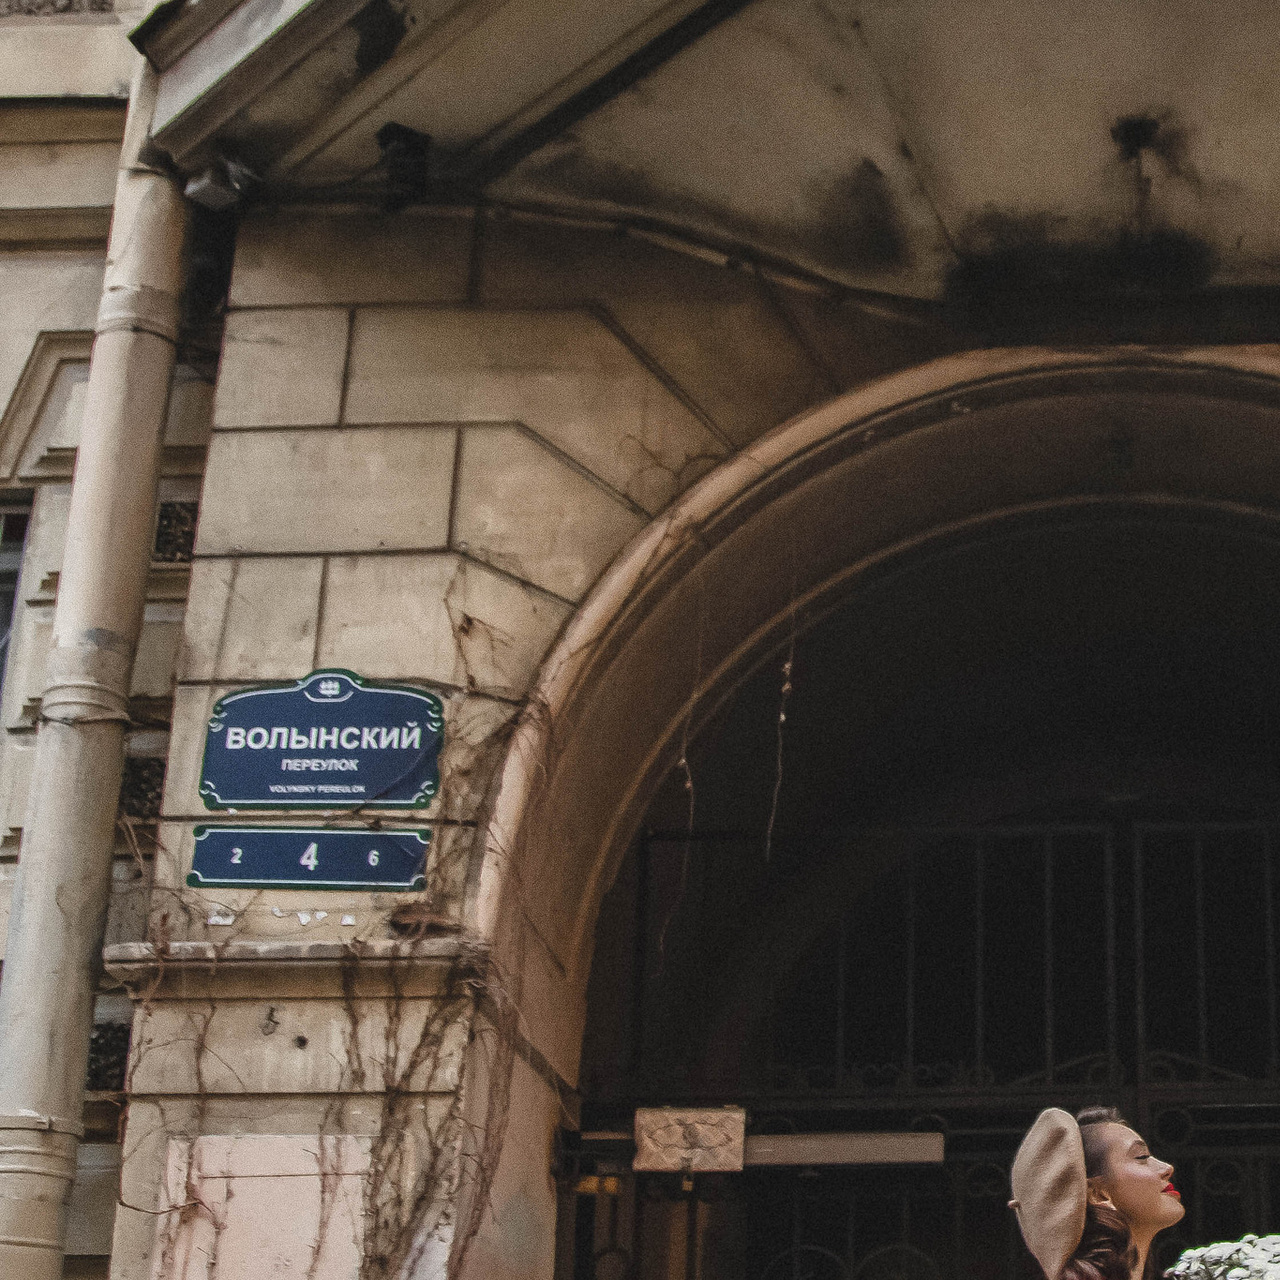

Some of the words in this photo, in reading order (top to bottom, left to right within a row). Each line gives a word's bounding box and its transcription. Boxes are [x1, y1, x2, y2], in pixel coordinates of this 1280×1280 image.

[225, 721, 422, 750] ВОЛЫНСКИЙ
[281, 758, 359, 771] ПЕРЕУЛОК
[230, 847, 243, 864] 2
[300, 842, 319, 871] 4
[368, 849, 380, 866] 6
